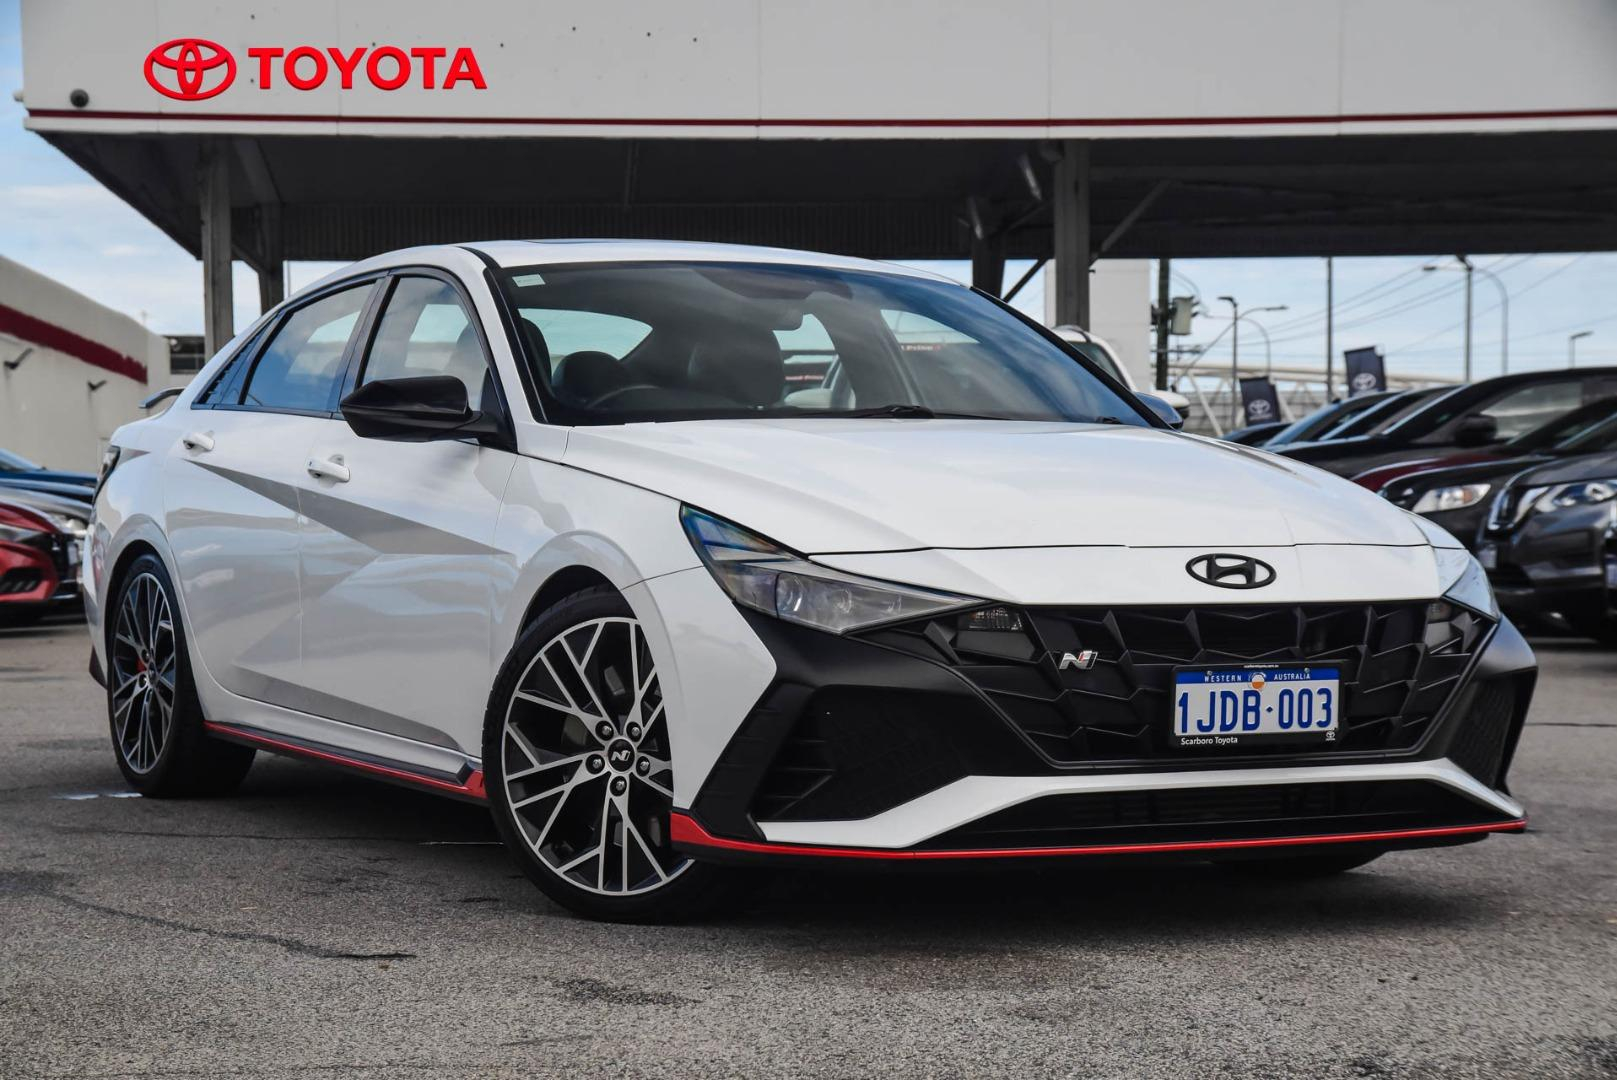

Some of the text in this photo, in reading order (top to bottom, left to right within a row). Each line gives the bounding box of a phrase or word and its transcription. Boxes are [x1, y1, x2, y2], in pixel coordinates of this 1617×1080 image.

[248, 46, 488, 91] TOYOTA
[1180, 736, 1238, 745] Scarboro Toyota
